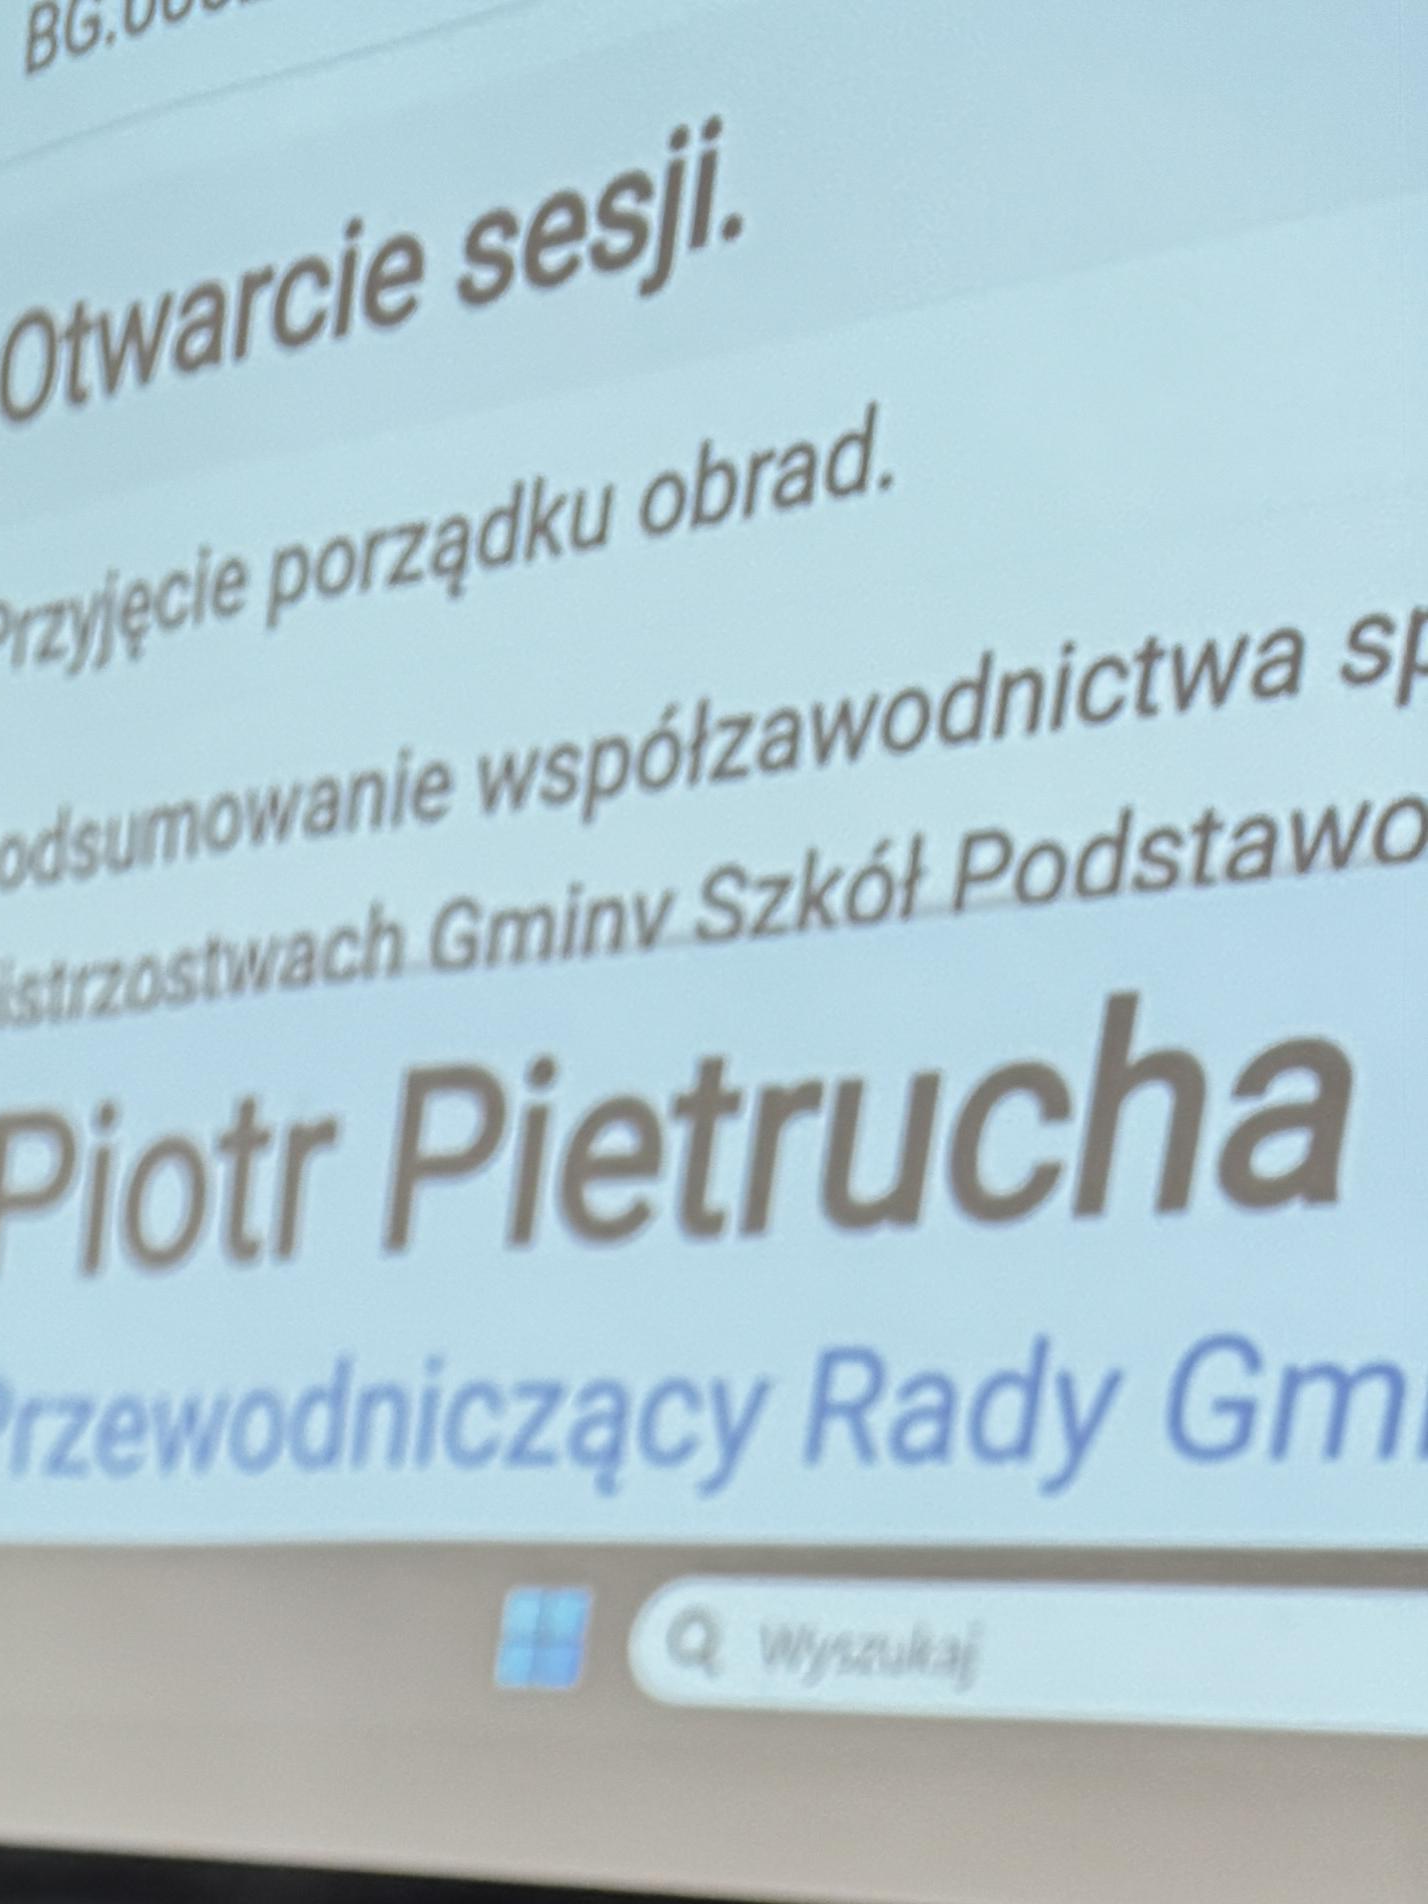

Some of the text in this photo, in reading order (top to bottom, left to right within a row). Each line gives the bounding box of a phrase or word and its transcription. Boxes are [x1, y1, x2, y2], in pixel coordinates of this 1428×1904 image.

[456, 113, 744, 309] sesji.
[265, 476, 615, 631] porządku
[637, 400, 894, 540] obrad.
[477, 627, 1307, 826] współzawodnictwa
[694, 831, 927, 947] Szkół
[953, 794, 1428, 914] Podstawo
[379, 991, 1357, 1260] Pietrucha
[803, 1336, 1124, 1498] Rady
